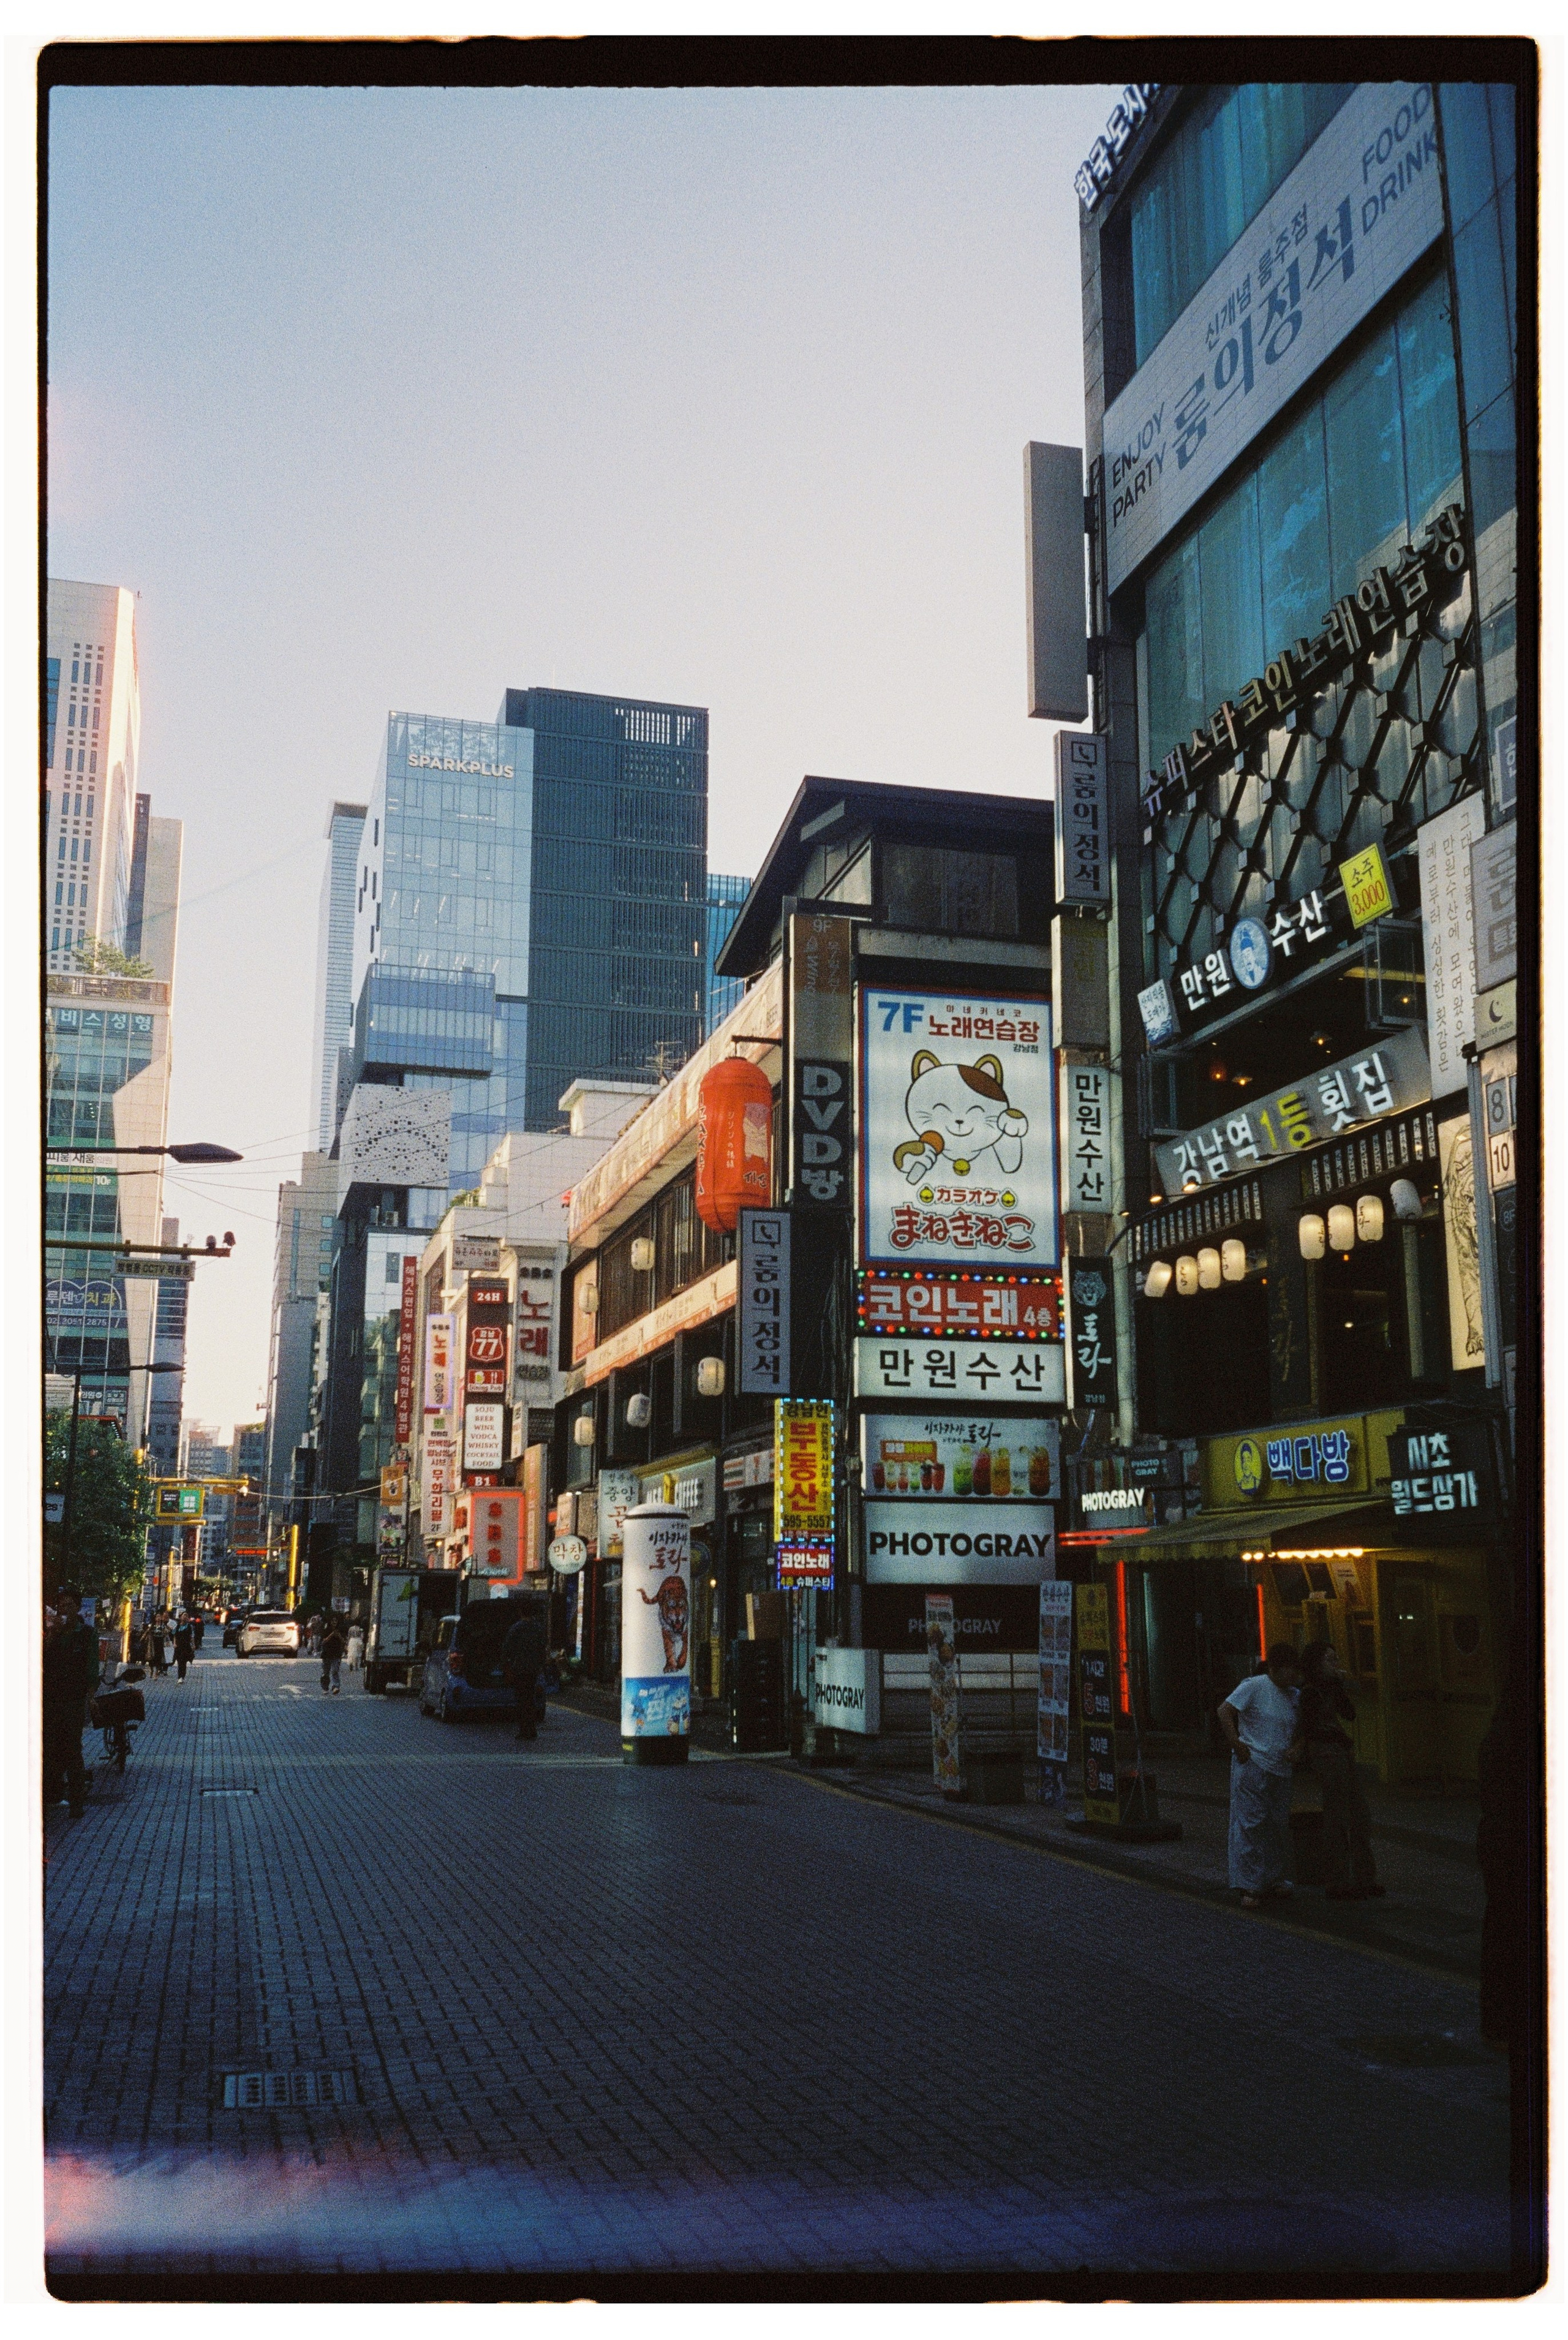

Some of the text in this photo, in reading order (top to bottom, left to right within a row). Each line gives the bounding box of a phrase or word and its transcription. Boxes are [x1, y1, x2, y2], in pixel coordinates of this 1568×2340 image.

[1074, 84, 1161, 212] 한국도시
[1361, 83, 1431, 185] FOOD
[1361, 130, 1438, 236] DRINK
[1205, 203, 1308, 352] 신개념 룸주점
[1172, 194, 1355, 470] 룸의정석
[1112, 401, 1166, 490] ENJOY
[1112, 442, 1167, 528] PARTY
[408, 753, 515, 779] SPARKPLUS
[1072, 772, 1101, 892] 룸의정석
[1351, 859, 1375, 888] 소주
[813, 919, 832, 933] 9F
[1180, 890, 1327, 1011] 만원 수산
[878, 1001, 925, 1033] 7F
[928, 1014, 1040, 1043] 노래연습장
[946, 1005, 1022, 1018] 마네키네코
[1013, 1043, 1039, 1054] 강남점
[1317, 1052, 1395, 1132] 횟집
[1491, 1089, 1504, 1123] 8
[801, 1065, 842, 1201] DVD방
[1075, 1074, 1104, 1202] 만원수산
[1493, 1142, 1510, 1173] 10
[937, 1187, 998, 1205] カラオケ
[890, 1204, 1034, 1251] まねきねこ
[86, 1291, 116, 1307] 치과
[477, 1292, 500, 1302] 24H
[870, 1284, 1052, 1327] 코인노래 4층
[520, 1289, 549, 1357] 노래
[752, 1253, 780, 1384] 룸의정석
[400, 1333, 412, 1398] 해커스어학원
[475, 1338, 499, 1356] 77
[1077, 1313, 1112, 1379] 토라
[880, 1349, 1046, 1391] 만원수산
[787, 1422, 819, 1512] 부동산
[1267, 1429, 1351, 1487] 빽다방
[431, 1469, 444, 1522] 무한리필
[475, 1476, 491, 1486] B1
[1082, 1487, 1145, 1512] PHOTOGRAY
[1390, 1470, 1479, 1515] 월드상가
[431, 1523, 441, 1532] 2F
[870, 1532, 1052, 1557] PHOTOGRAY
[552, 1542, 583, 1561] 막창
[782, 1553, 831, 1569] 코인노래
[908, 1618, 1001, 1634] PHOGRAY
[816, 1682, 864, 1710] PHOTOGRAY
